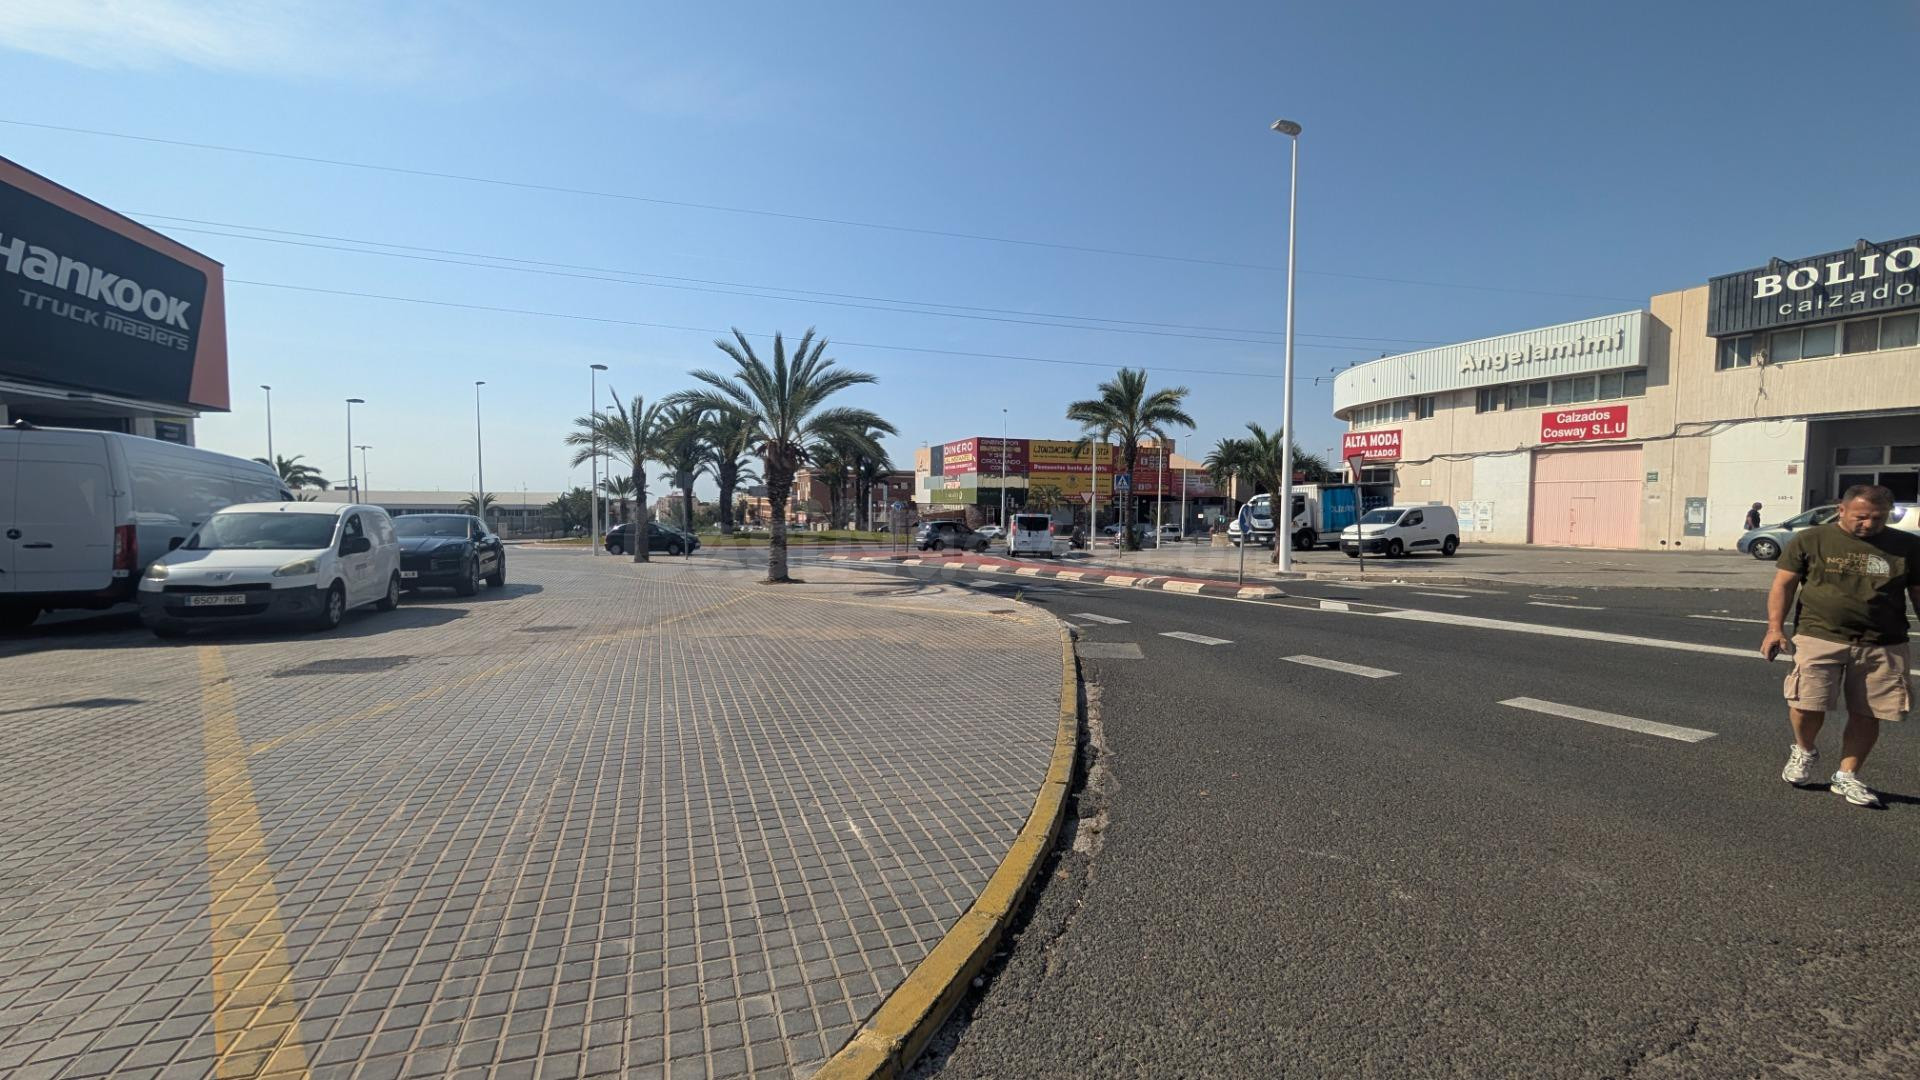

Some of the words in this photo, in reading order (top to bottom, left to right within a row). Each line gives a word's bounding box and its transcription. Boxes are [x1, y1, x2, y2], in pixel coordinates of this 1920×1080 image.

[1753, 246, 1920, 299] BOLIO
[1779, 283, 1914, 315] calzado
[103, 312, 190, 351] masters
[1460, 329, 1624, 373] Angelamimi
[1556, 411, 1611, 424] Calzados
[1345, 435, 1367, 448] ALTA
[1369, 433, 1399, 446] MODA
[1543, 427, 1587, 438] Cosway
[1592, 422, 1625, 435] S.L.U
[944, 442, 973, 455] DINERO
